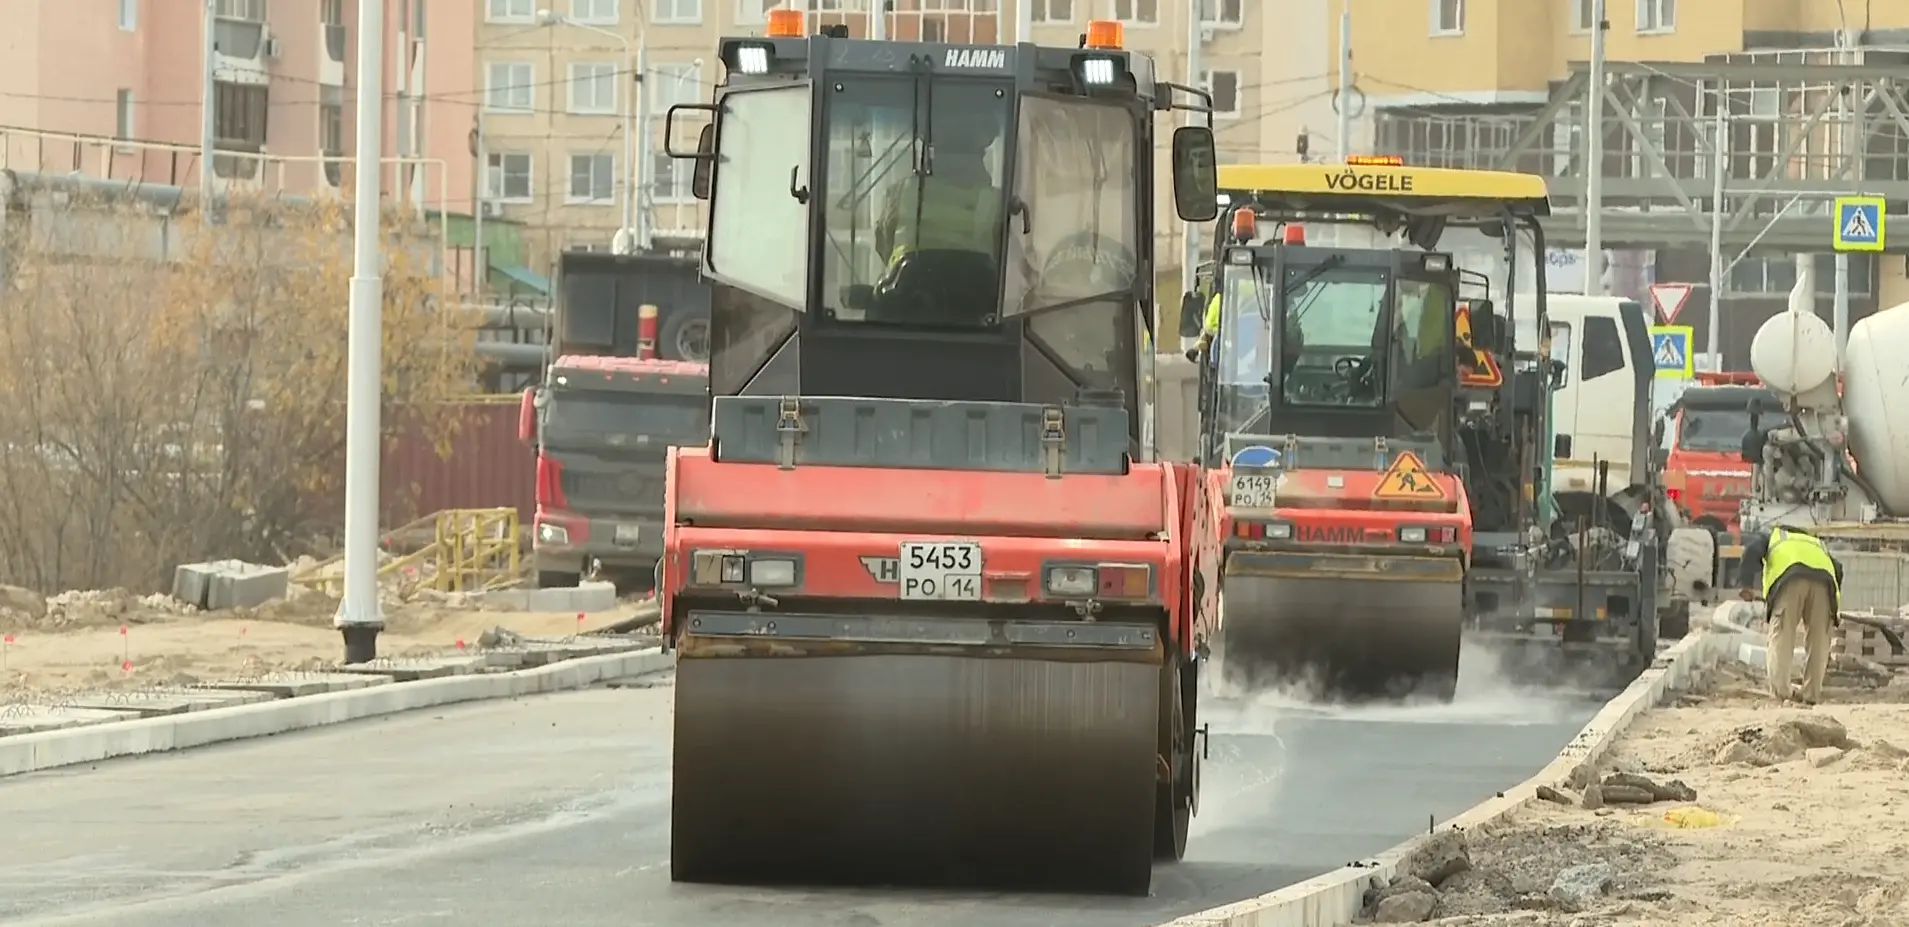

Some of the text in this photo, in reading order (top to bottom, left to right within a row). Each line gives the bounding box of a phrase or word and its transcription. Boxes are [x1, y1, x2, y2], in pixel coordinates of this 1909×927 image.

[945, 48, 1005, 68] HAMM
[1325, 168, 1413, 191] VÖGELE
[1236, 476, 1271, 491] 6149
[1297, 525, 1364, 543] HAMM
[910, 546, 972, 569] 5453
[952, 578, 974, 597] 14
